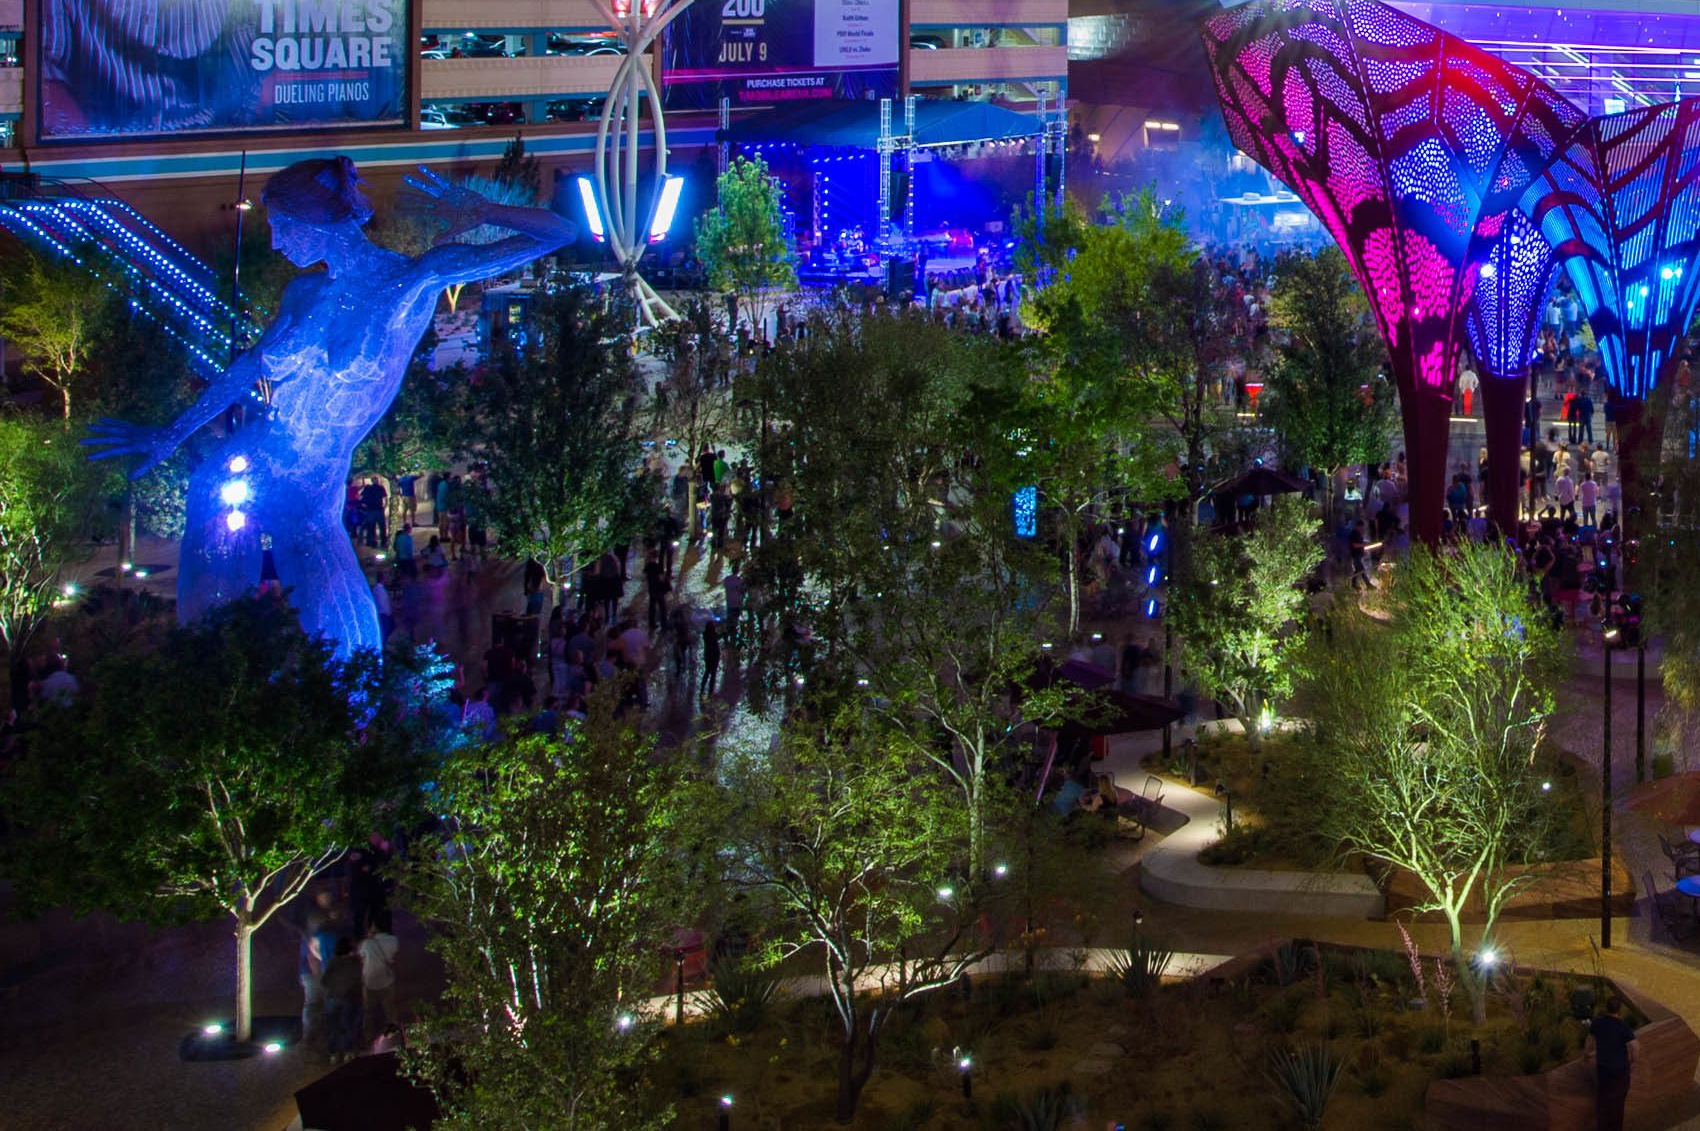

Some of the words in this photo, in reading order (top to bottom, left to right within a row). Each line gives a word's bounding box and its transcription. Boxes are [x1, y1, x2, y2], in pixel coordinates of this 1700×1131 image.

[251, 36, 392, 71] SQUARE
[719, 42, 754, 62] JULY
[758, 42, 768, 61] 9
[274, 84, 325, 105] DUELING
[327, 82, 369, 103] PIANOS
[747, 78, 786, 89] PURCHASE
[787, 77, 815, 87] TICKETS
[815, 77, 825, 86] AT
